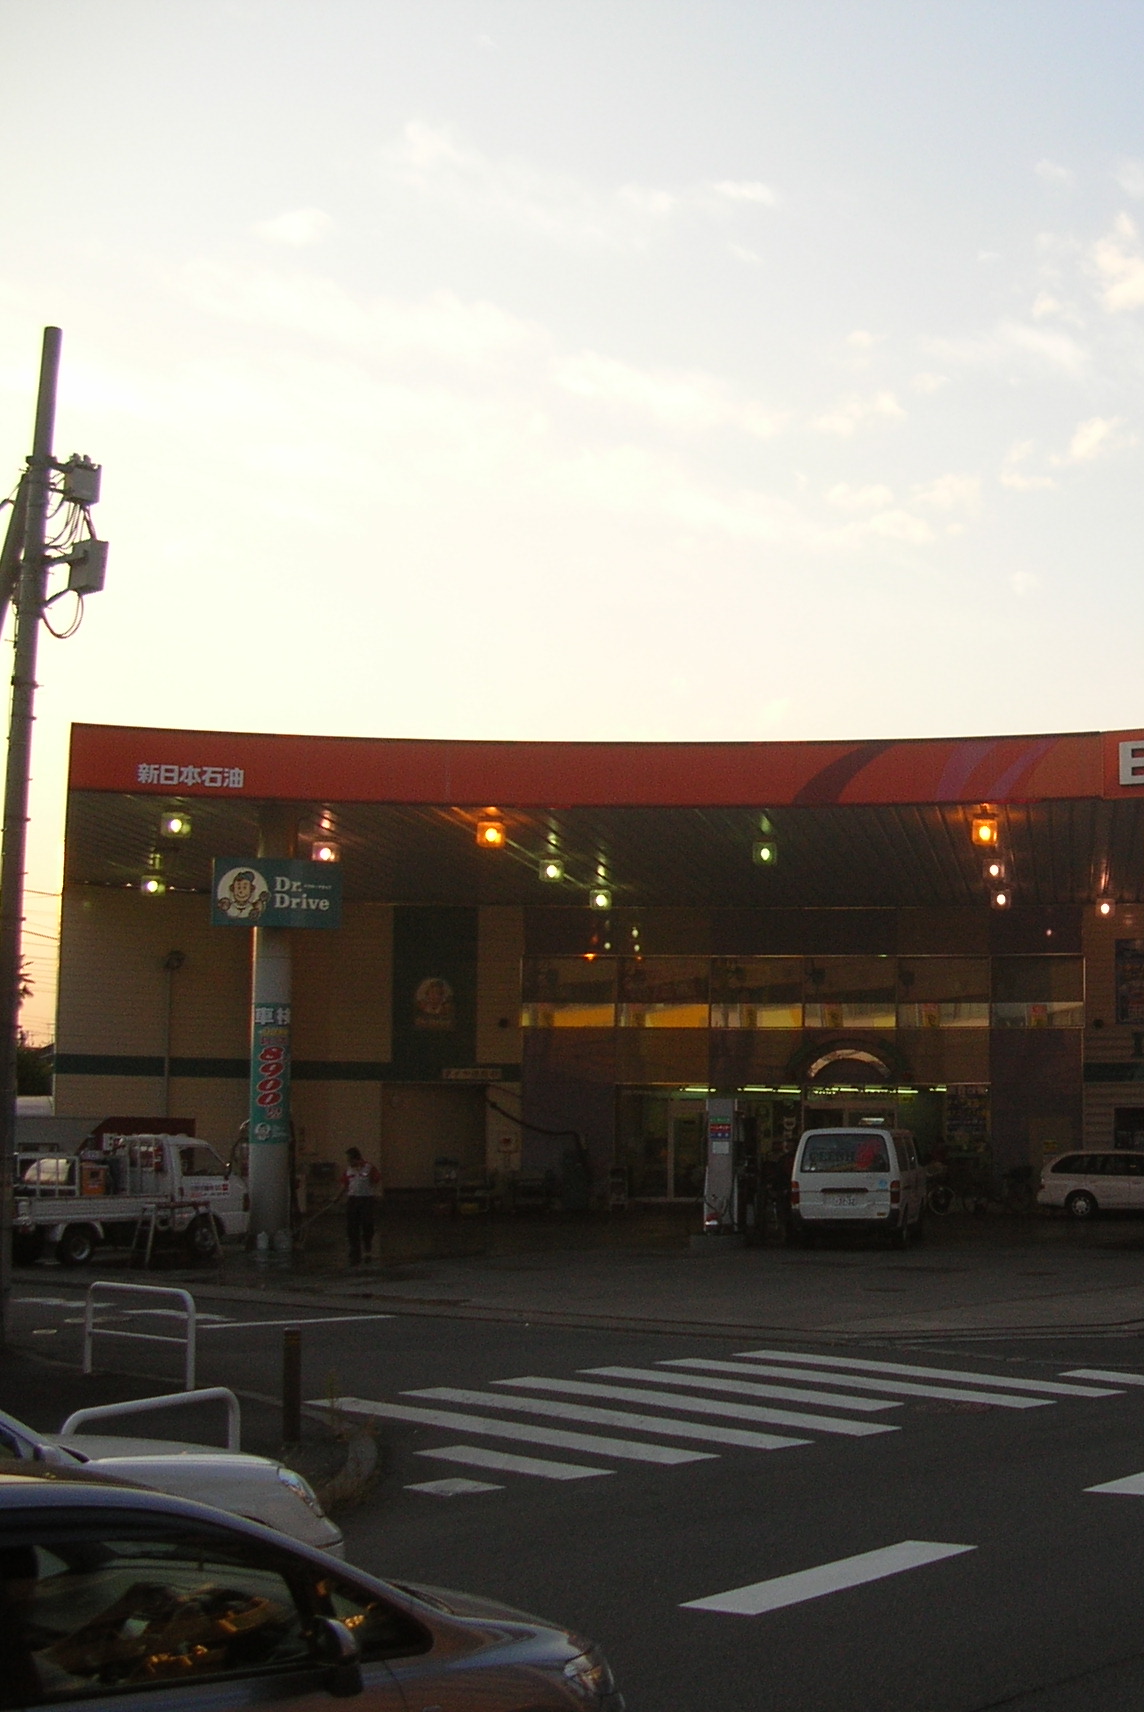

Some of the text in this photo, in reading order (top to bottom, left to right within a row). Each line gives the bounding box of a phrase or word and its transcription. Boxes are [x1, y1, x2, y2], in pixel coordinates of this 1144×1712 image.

[137, 763, 245, 788] 新日本石油
[273, 876, 303, 893] Dr.
[273, 893, 330, 911] Drive
